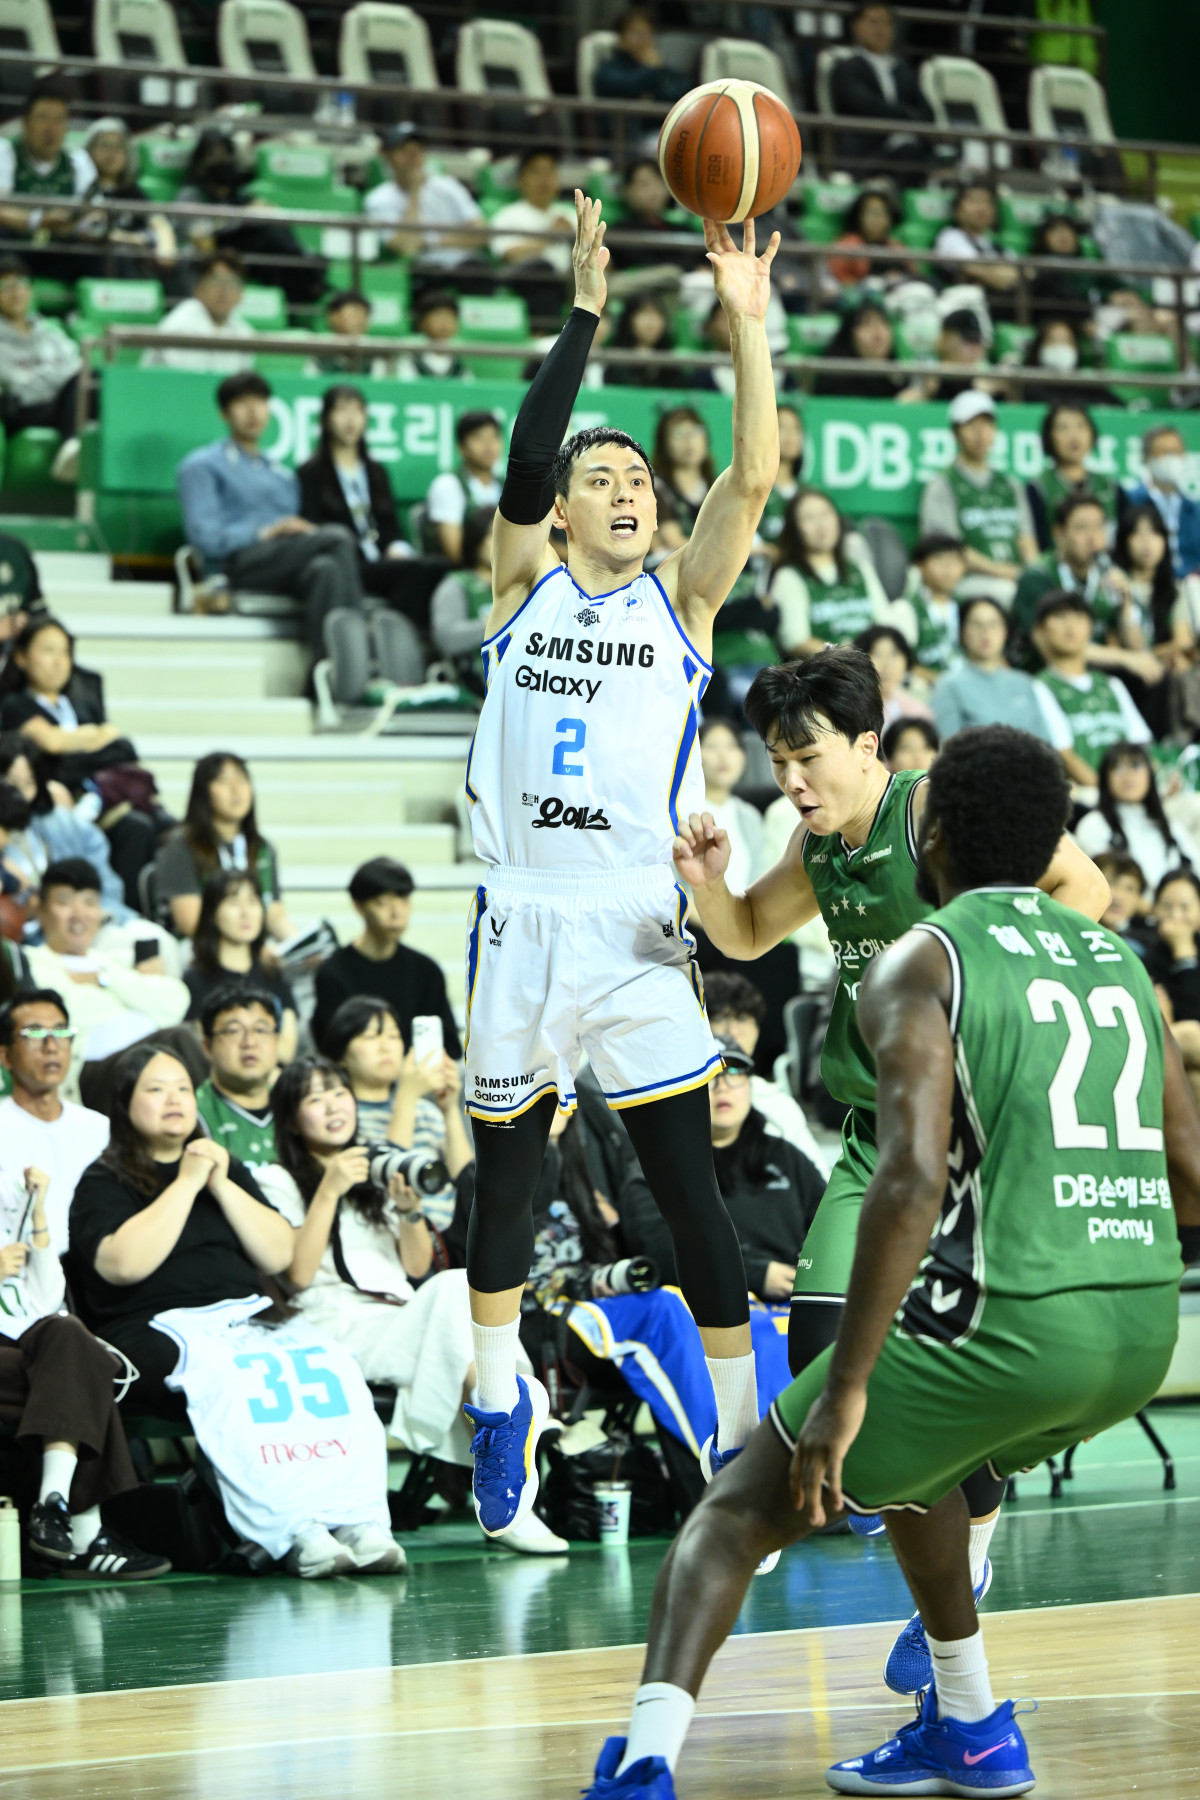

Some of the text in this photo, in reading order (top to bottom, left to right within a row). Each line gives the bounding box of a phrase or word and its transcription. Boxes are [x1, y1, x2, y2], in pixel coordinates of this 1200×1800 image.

[707, 153, 722, 185] FIBA
[525, 632, 655, 668] SAMSUNG
[515, 665, 602, 704] Galaxy
[552, 717, 587, 777] 2
[531, 797, 611, 830] 오예스
[474, 1073, 535, 1089] SAMSUNG
[1025, 977, 1163, 1151] 22
[474, 1089, 516, 1103] Galaxy
[1088, 1217, 1154, 1246] promy
[233, 1345, 351, 1424] 35
